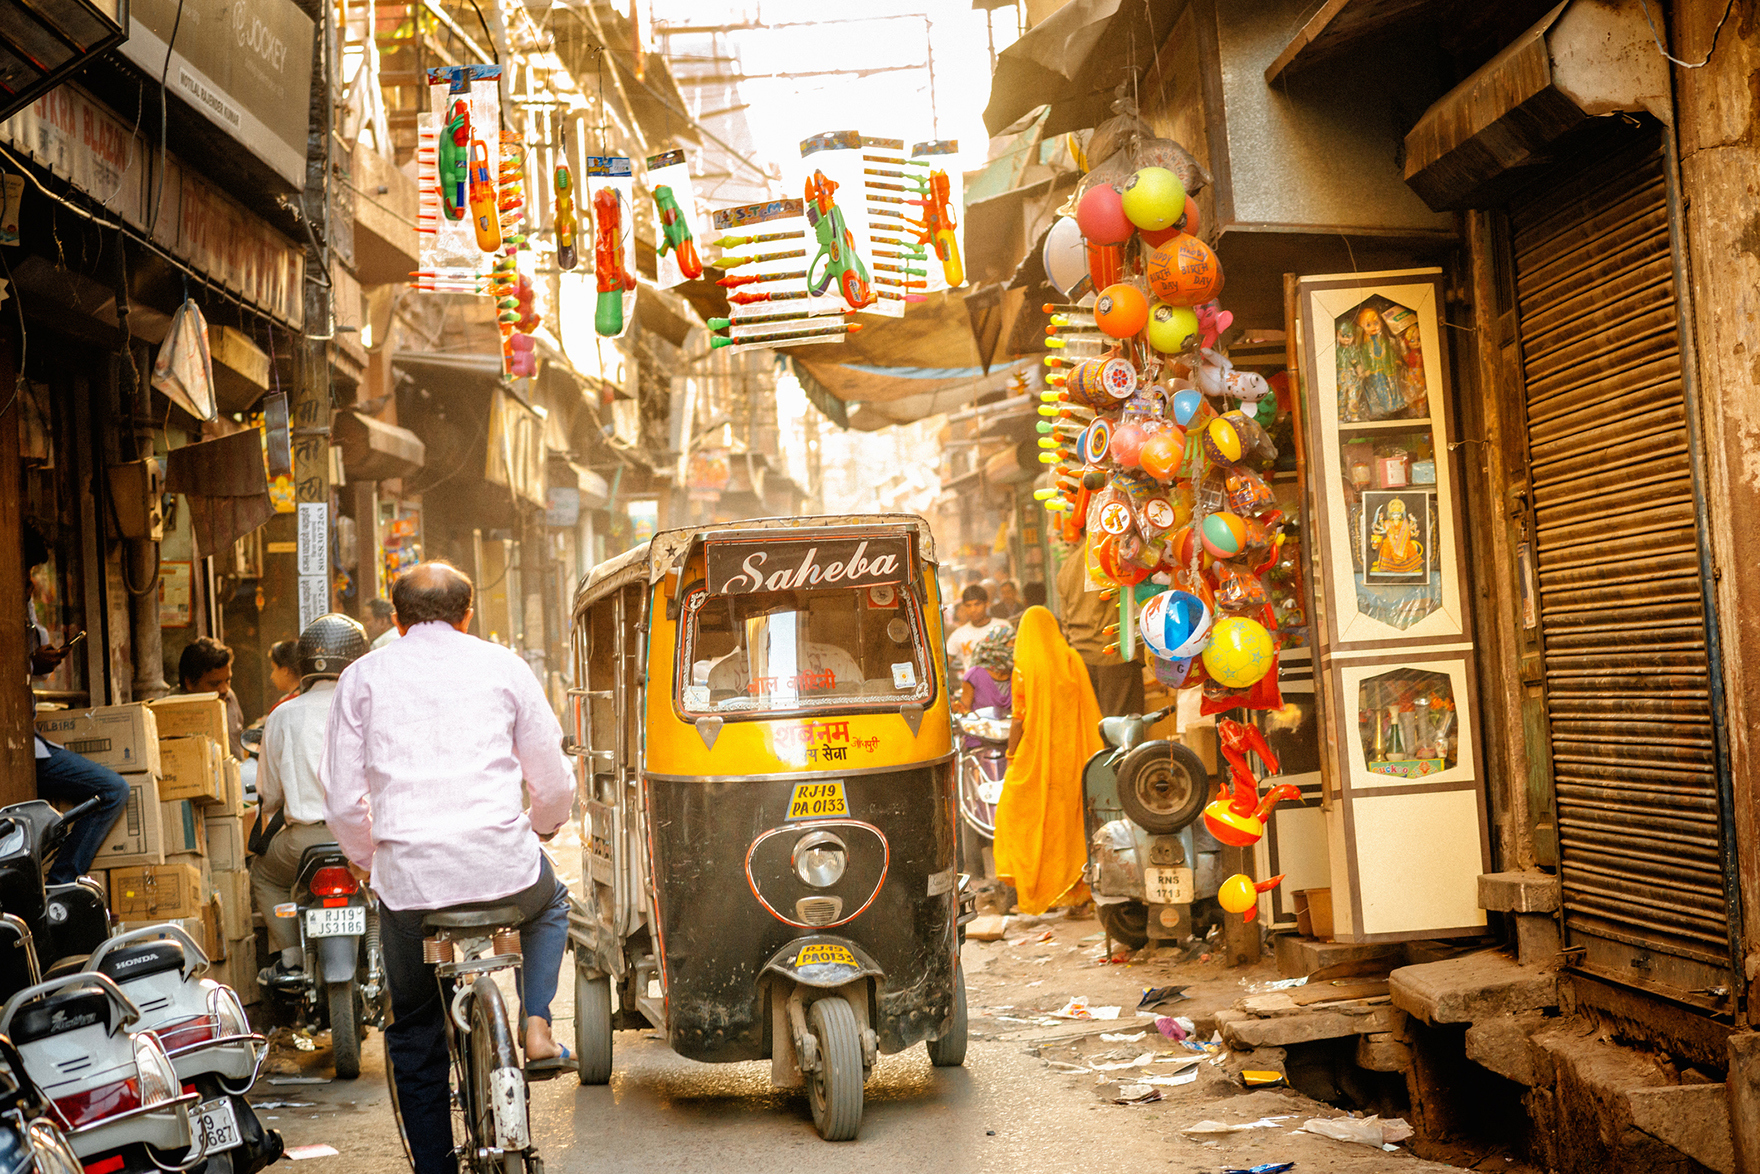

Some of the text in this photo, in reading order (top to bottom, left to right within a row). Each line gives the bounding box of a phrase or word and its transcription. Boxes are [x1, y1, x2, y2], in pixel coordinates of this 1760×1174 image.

[246, 17, 288, 74] JOCKEY
[1181, 263, 1209, 275] BIRTH
[1193, 275, 1213, 289] DAY
[721, 541, 899, 593] Saheba
[787, 668, 836, 691] वाहिनी
[822, 744, 848, 762] सेवा
[1158, 876, 1180, 884] RNS
[325, 909, 355, 922] RJ19
[318, 921, 362, 934] JS3186
[115, 953, 159, 970] HONDA
